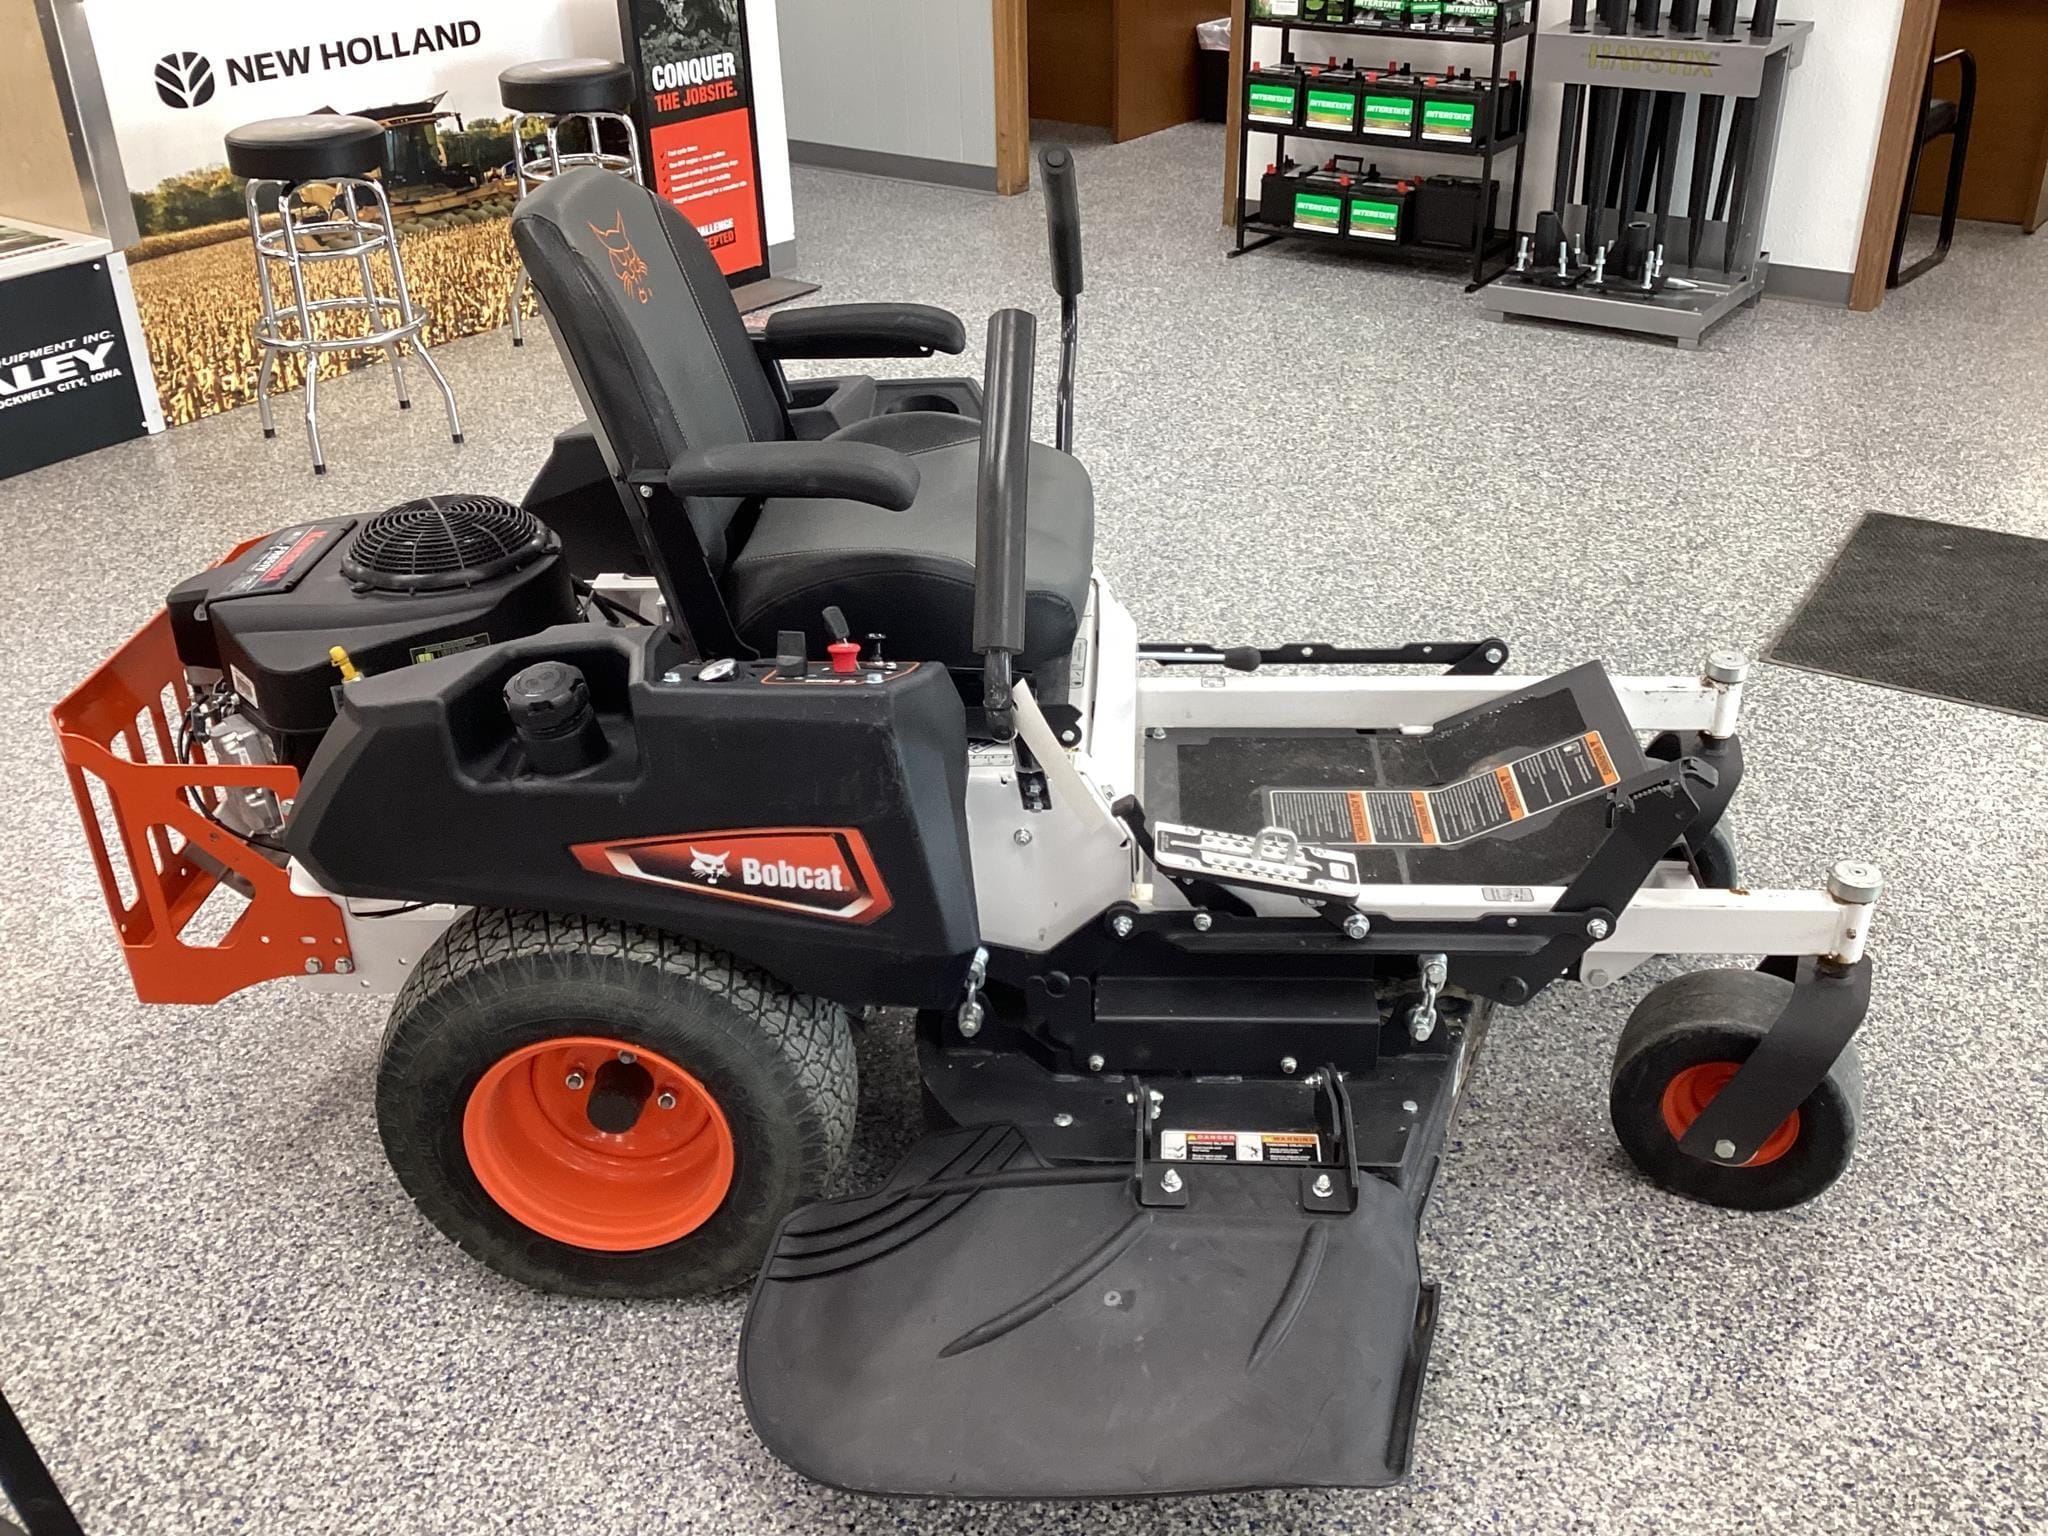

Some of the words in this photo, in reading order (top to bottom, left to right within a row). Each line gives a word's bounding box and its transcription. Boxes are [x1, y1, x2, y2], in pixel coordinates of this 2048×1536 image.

[226, 46, 310, 86] NEW
[319, 20, 481, 70] HOLLAND
[652, 52, 736, 91] CONQUER
[654, 91, 680, 112] THE
[683, 80, 738, 106] JOBSITE.
[696, 217, 734, 237] ALLENGE
[0, 339, 76, 369] UIPMENT
[83, 330, 115, 345] INC.
[57, 377, 88, 392] CITY,
[90, 368, 122, 383] IOWA
[741, 857, 843, 892] Bobcat
